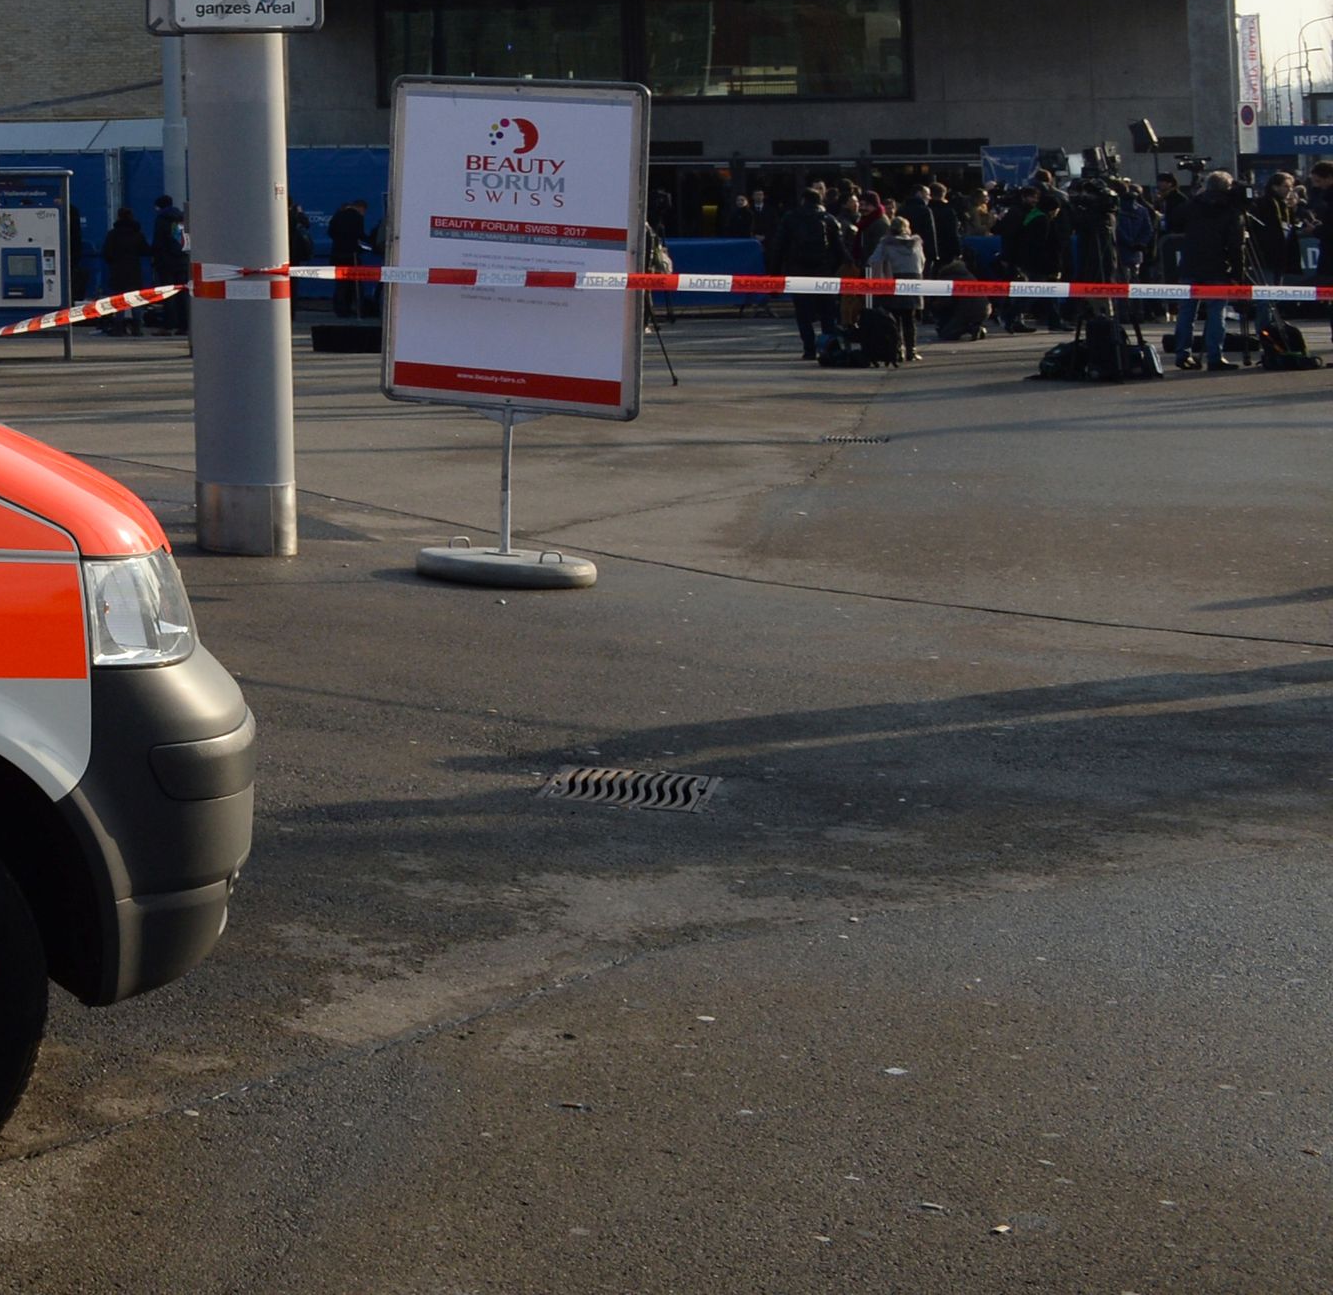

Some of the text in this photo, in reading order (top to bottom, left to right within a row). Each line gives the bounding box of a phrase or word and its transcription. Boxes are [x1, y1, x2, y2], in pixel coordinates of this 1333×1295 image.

[195, 1, 296, 18] ganzes Areal
[465, 154, 565, 175] BEAUTY
[465, 172, 565, 193] FORUM
[464, 188, 564, 208] SWISS
[434, 218, 587, 237] BEAUTY FORUM SWISS 2017
